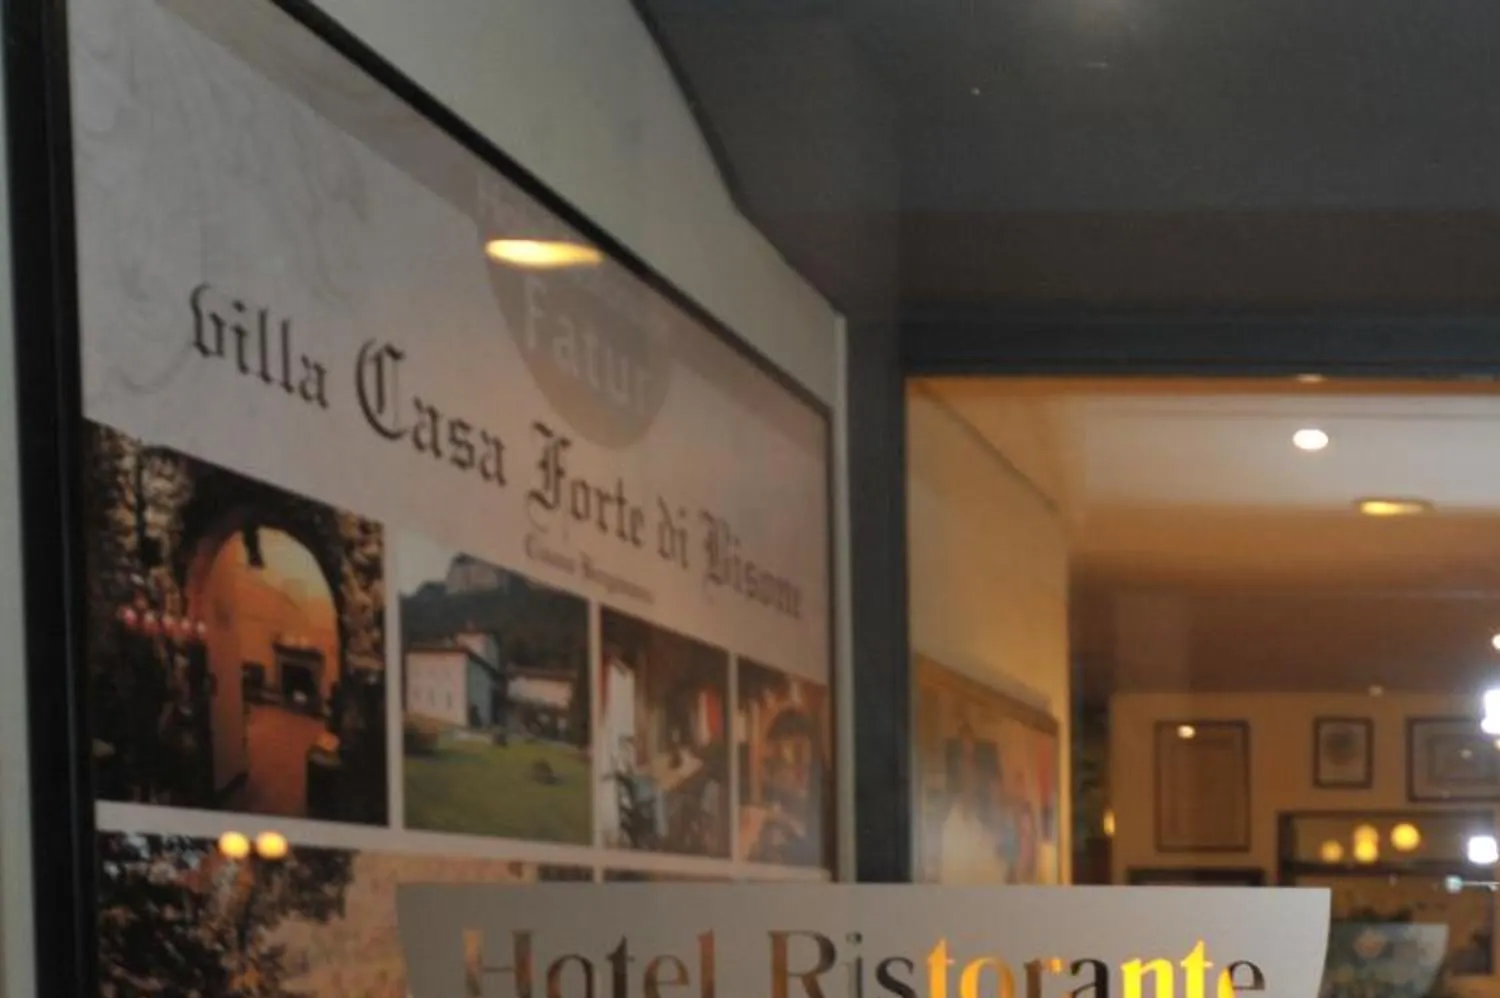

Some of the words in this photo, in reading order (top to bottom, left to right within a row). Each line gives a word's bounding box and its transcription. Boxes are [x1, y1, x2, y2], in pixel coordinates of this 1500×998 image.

[353, 337, 506, 487] Casa
[524, 420, 646, 550] Forte
[656, 493, 690, 572] di
